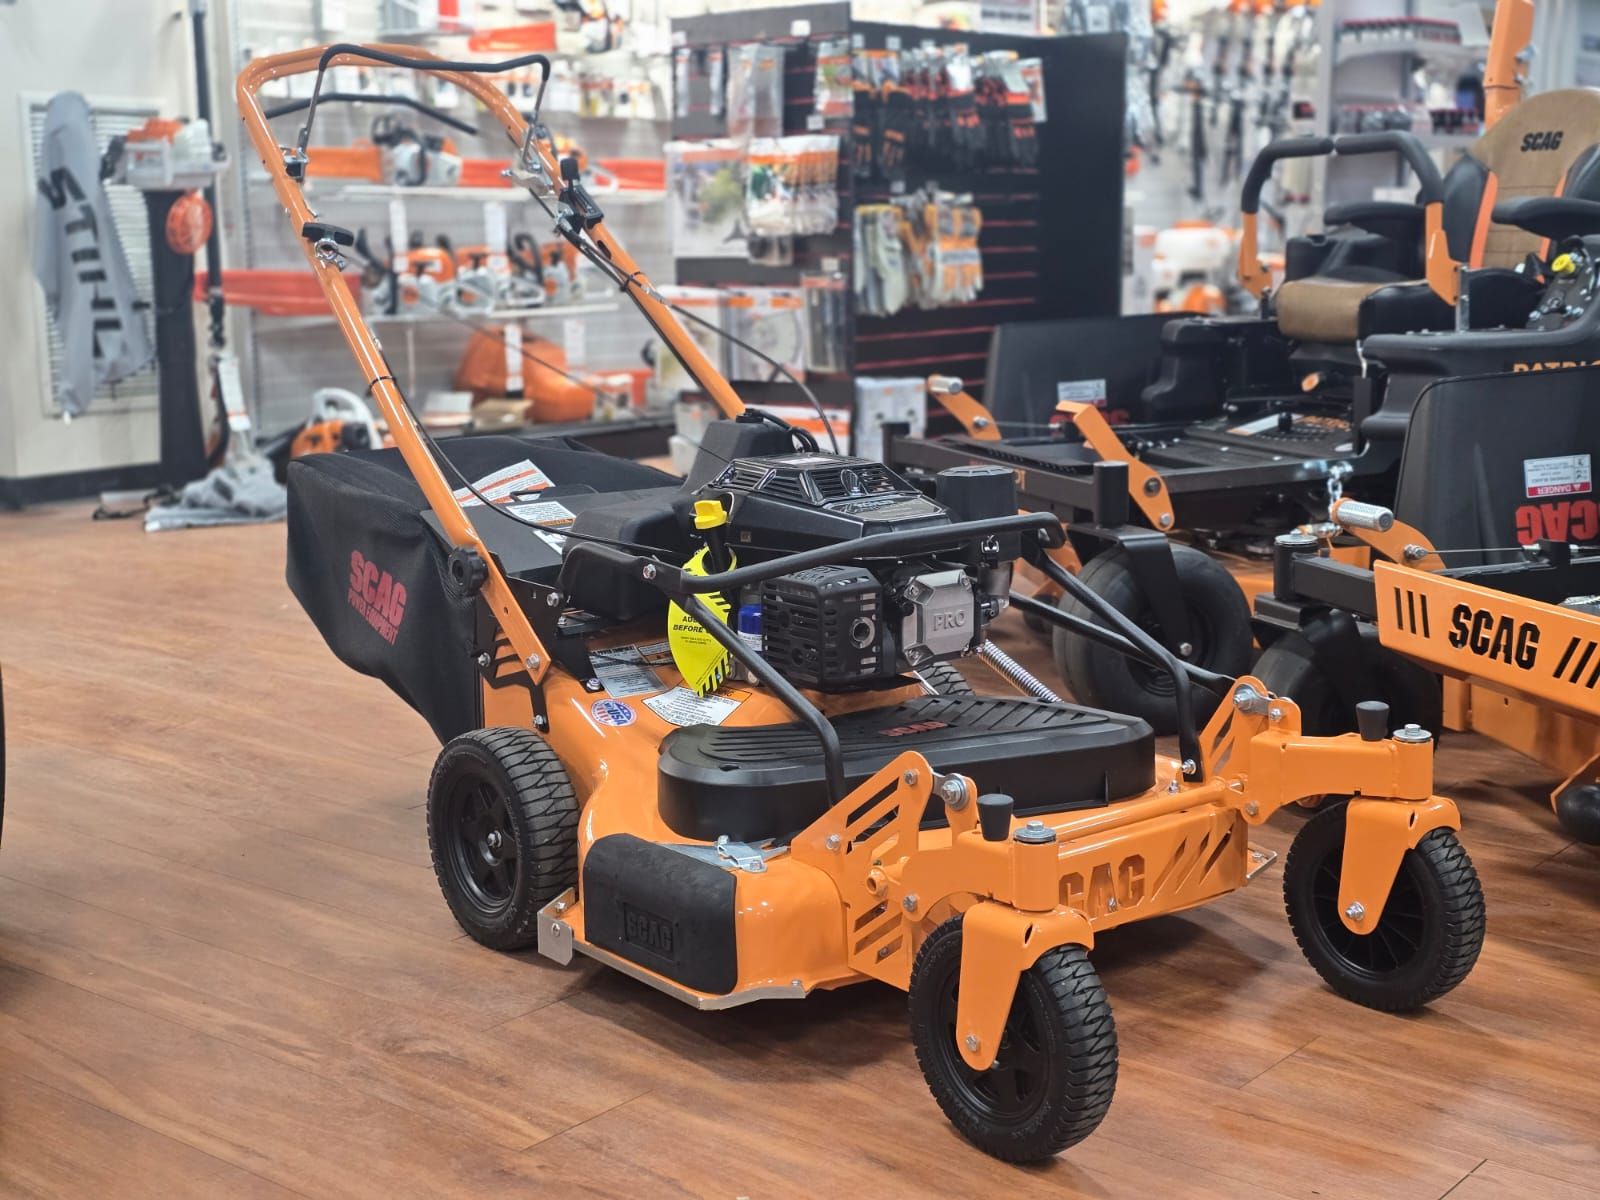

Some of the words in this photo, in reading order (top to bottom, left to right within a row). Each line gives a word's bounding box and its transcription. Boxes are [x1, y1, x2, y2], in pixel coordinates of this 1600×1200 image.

[1520, 131, 1564, 152] SCAG
[1537, 483, 1571, 495] DANGER
[1515, 499, 1600, 546] CAG
[350, 550, 407, 627] SCAG
[673, 624, 704, 633] BEFORE
[933, 610, 966, 631] PRO
[1448, 603, 1541, 671] SCAG
[607, 709, 630, 725] USA
[1058, 853, 1145, 917] CAG
[626, 911, 673, 951] SCAG
